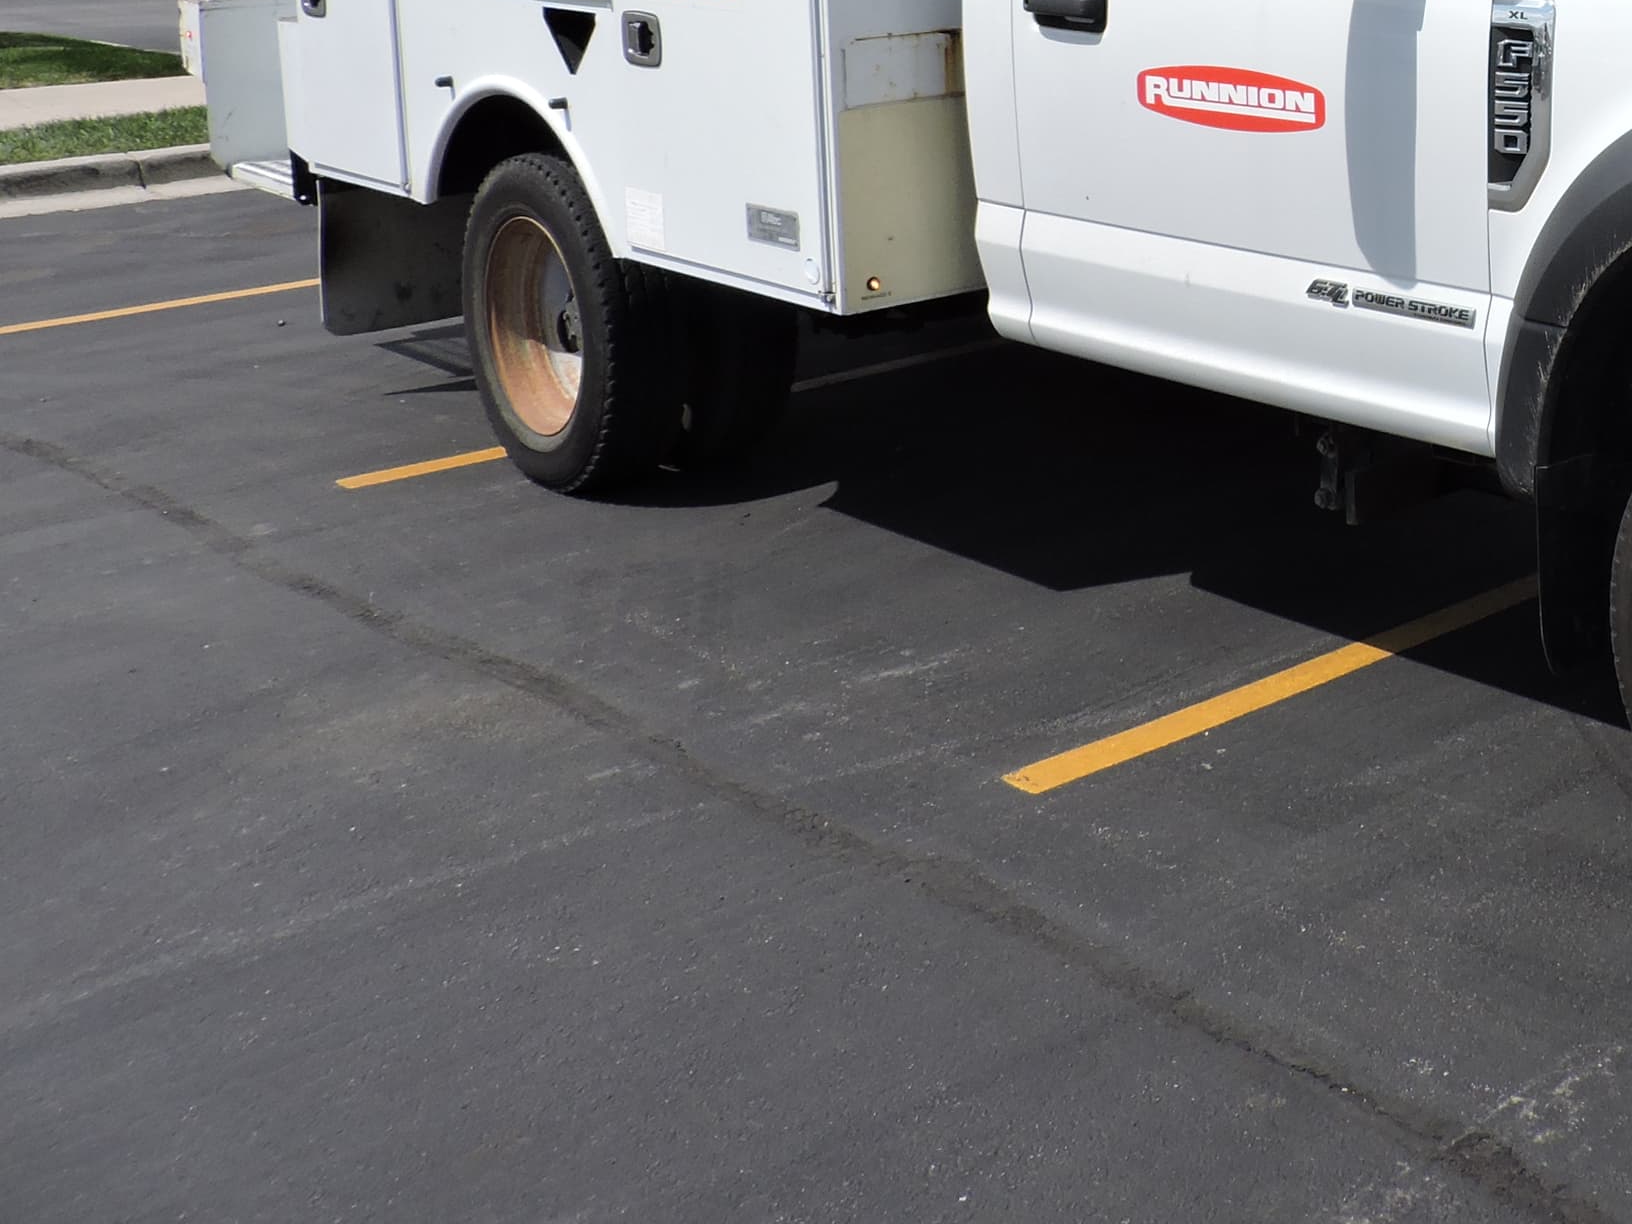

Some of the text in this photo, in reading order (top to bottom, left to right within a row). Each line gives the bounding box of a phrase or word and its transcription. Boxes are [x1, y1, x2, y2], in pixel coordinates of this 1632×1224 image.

[1508, 10, 1529, 20] XL
[1145, 75, 1316, 123] RUNNION
[1354, 289, 1406, 309] POWER
[1408, 299, 1471, 322] STROKE
